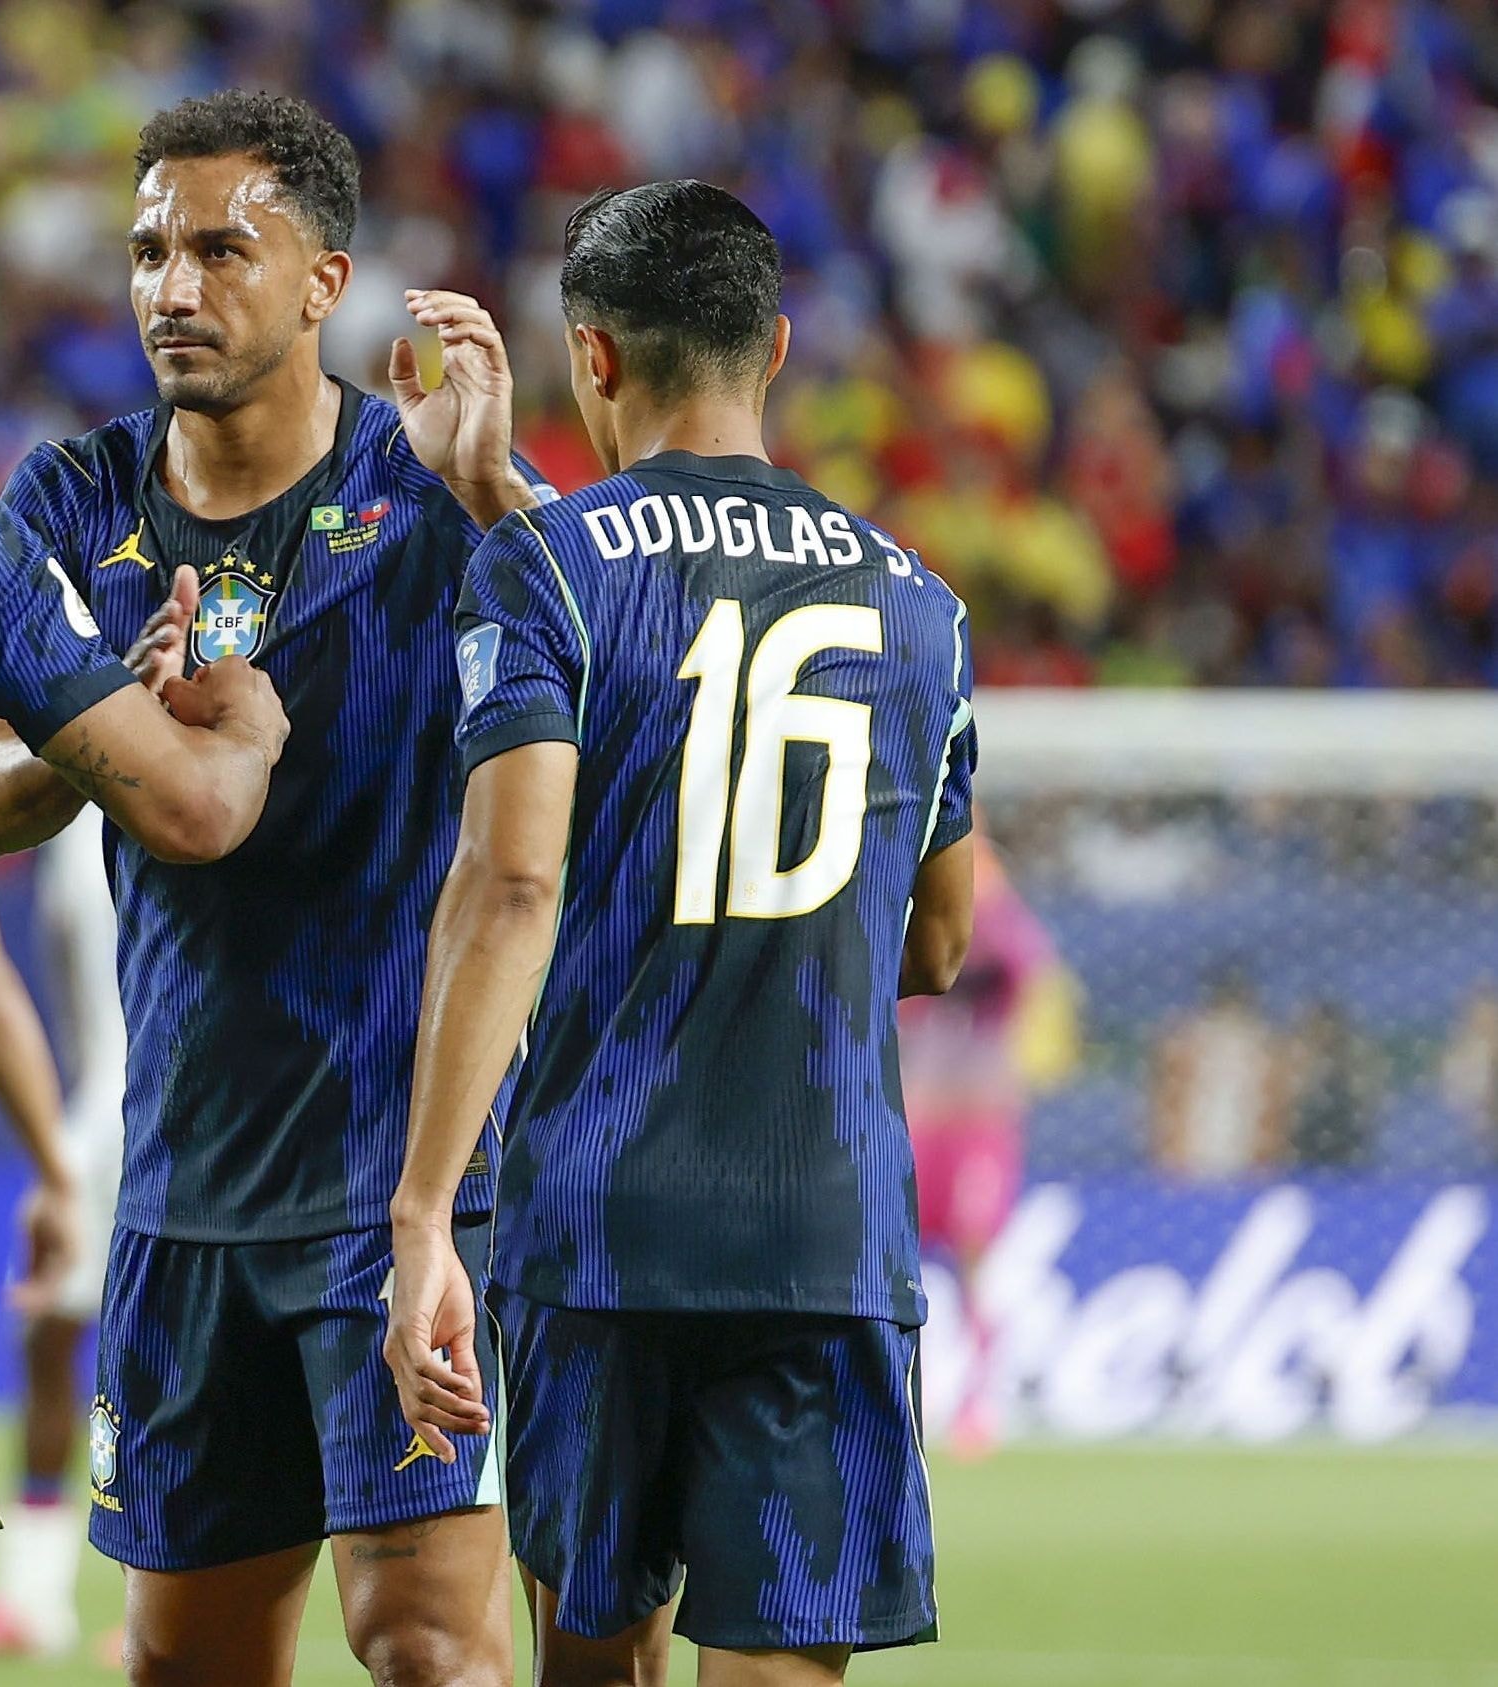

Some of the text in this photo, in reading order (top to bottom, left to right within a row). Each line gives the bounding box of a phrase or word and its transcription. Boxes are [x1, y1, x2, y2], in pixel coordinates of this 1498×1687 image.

[582, 494, 925, 588] DOUGLAS S.
[215, 616, 244, 628] CBF
[673, 598, 883, 925] 16
